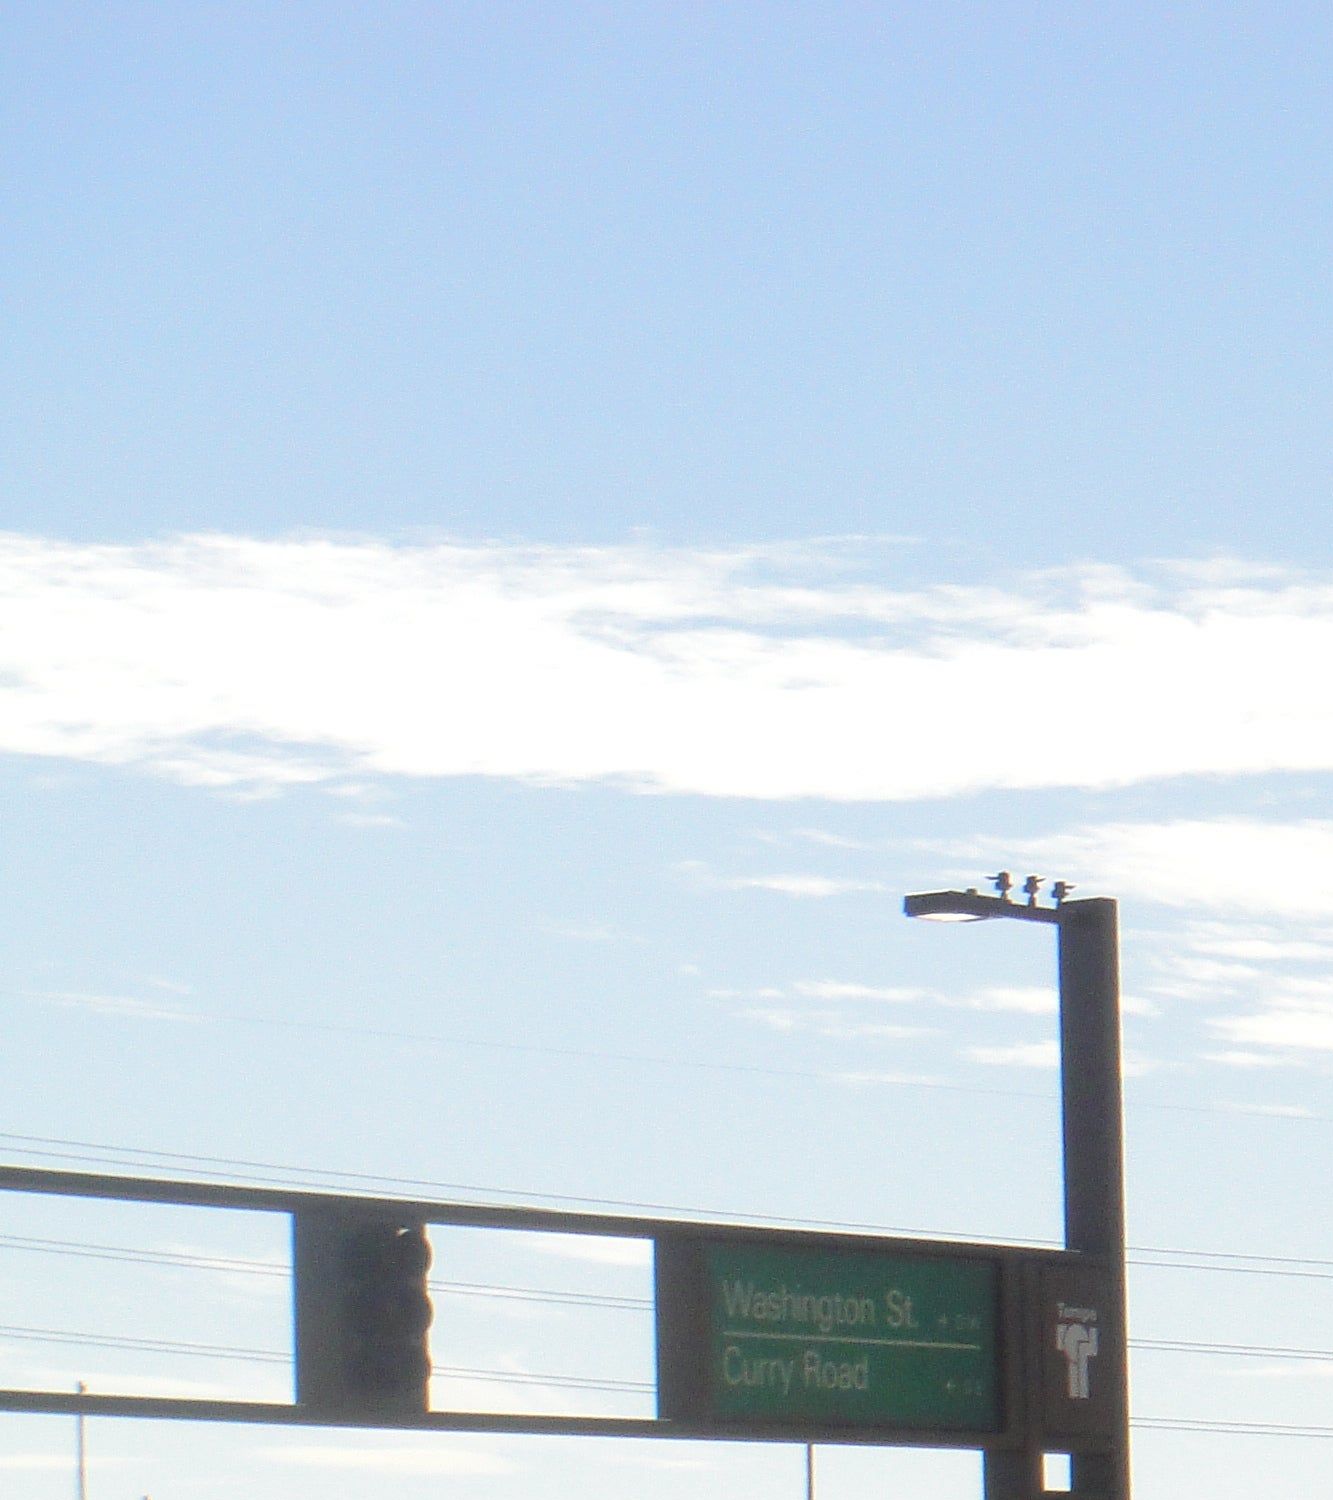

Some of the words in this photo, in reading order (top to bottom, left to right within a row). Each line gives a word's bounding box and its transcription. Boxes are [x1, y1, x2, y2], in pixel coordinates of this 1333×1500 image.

[721, 1280, 875, 1333] Washington
[724, 1345, 794, 1396] Curry
[803, 1351, 870, 1390] Road
